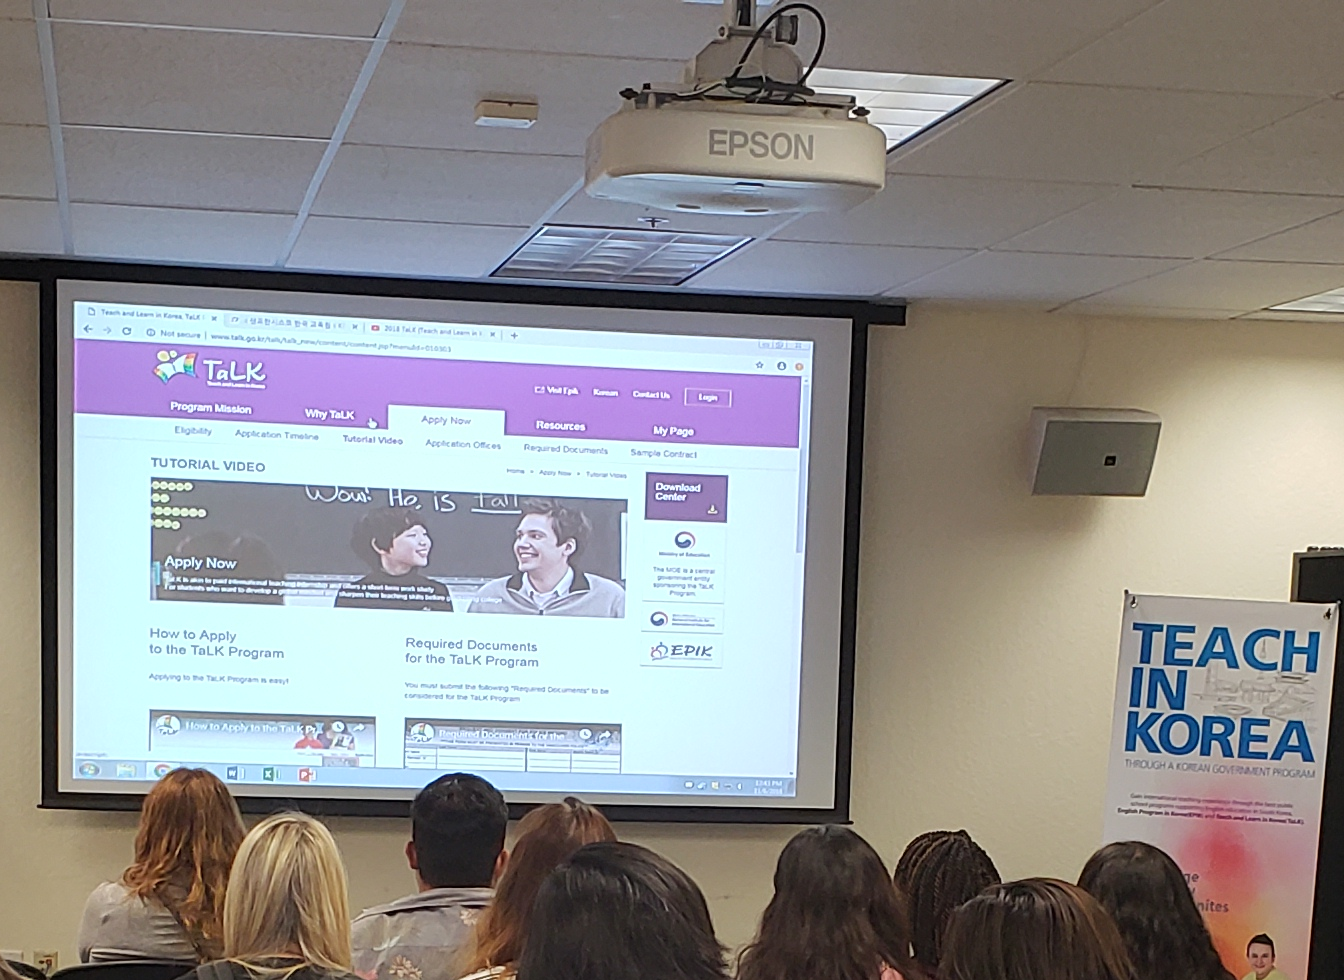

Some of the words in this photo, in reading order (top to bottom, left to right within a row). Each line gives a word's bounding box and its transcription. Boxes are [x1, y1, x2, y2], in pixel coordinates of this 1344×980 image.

[708, 129, 815, 161] EPSON
[101, 308, 120, 317] Teach
[185, 313, 200, 321] TaLK
[160, 330, 175, 338] Not
[384, 325, 400, 333] 2018
[440, 328, 451, 336] and
[453, 329, 470, 337] Learn
[202, 359, 267, 382] TaLK
[593, 388, 619, 398] Korean
[632, 390, 659, 399] Contact
[660, 391, 671, 400] Us
[698, 393, 718, 403] Login
[170, 401, 212, 414] Program
[214, 403, 253, 415] Mission
[305, 408, 328, 421] Why
[329, 410, 355, 420] TaLK
[421, 415, 448, 427] Apply
[450, 416, 472, 426] Now
[536, 420, 586, 432] Resources
[174, 425, 212, 437] Eligibility
[235, 428, 282, 440] Application
[284, 431, 320, 441] Timeline
[653, 425, 668, 438] My
[669, 426, 695, 438] Page
[343, 434, 376, 444] Tutorial
[378, 436, 404, 446] Video
[425, 438, 471, 450] Application
[473, 440, 502, 451] Offices
[524, 443, 561, 455] Required
[562, 445, 609, 456] Documents
[630, 448, 661, 459] Sample
[663, 449, 698, 460] Contract
[150, 457, 221, 471] TUTORIAL
[223, 460, 266, 473] VIDEO
[506, 467, 526, 475] Home
[539, 469, 557, 477] Apply
[586, 470, 609, 479] Tutorial
[609, 472, 628, 480] Video
[654, 482, 702, 493] Download
[305, 485, 372, 503] Wow!
[434, 490, 456, 512] is
[654, 492, 688, 502] Center
[164, 555, 203, 571] Apply
[206, 557, 238, 570] Now
[695, 567, 716, 575] central
[694, 575, 711, 583] entity
[246, 587, 272, 595] develop
[653, 582, 687, 590] sponsoring
[149, 627, 180, 639] How
[183, 629, 196, 640] to
[199, 629, 237, 644] Apply
[406, 637, 463, 651] Required
[467, 639, 538, 653] Documents
[671, 644, 714, 657] EPIK
[1132, 622, 1321, 674] TEACH
[149, 644, 162, 655] to
[166, 644, 187, 655] the
[190, 644, 225, 657] TaLK
[228, 646, 285, 660] Program
[405, 653, 422, 664] for
[425, 653, 446, 664] the
[449, 654, 482, 666] TaLK
[485, 655, 539, 669] Program
[148, 672, 182, 683] Applying
[182, 674, 191, 682] to
[192, 674, 205, 682] the
[206, 674, 226, 683] TaLK
[227, 675, 260, 685] Program
[261, 676, 268, 684] is
[405, 681, 419, 689] You
[420, 682, 438, 690] must
[440, 683, 464, 691] submit
[465, 683, 477, 691] the
[478, 684, 509, 693] following
[591, 687, 599, 695] to
[600, 687, 610, 695] be
[1129, 666, 1188, 711] IN
[404, 692, 444, 700] considered
[445, 692, 455, 700] for
[456, 693, 469, 701] the
[470, 693, 489, 702] TaLK
[184, 721, 208, 731] How
[209, 722, 220, 732] to
[221, 722, 248, 734] Apply
[250, 723, 261, 733] to
[262, 723, 279, 733] the
[280, 724, 304, 734] TaLK
[439, 728, 479, 741] Required
[481, 730, 532, 741] Documents
[534, 730, 549, 740] for
[550, 731, 565, 741] the
[1124, 711, 1316, 763] KOREA
[1125, 758, 1166, 770] THROUGH
[1167, 761, 1175, 770] A
[1176, 762, 1211, 773] KOREAN
[1212, 764, 1271, 777] GOVERNMENT
[1272, 768, 1316, 779] PROGRAM
[1139, 808, 1164, 817] Program
